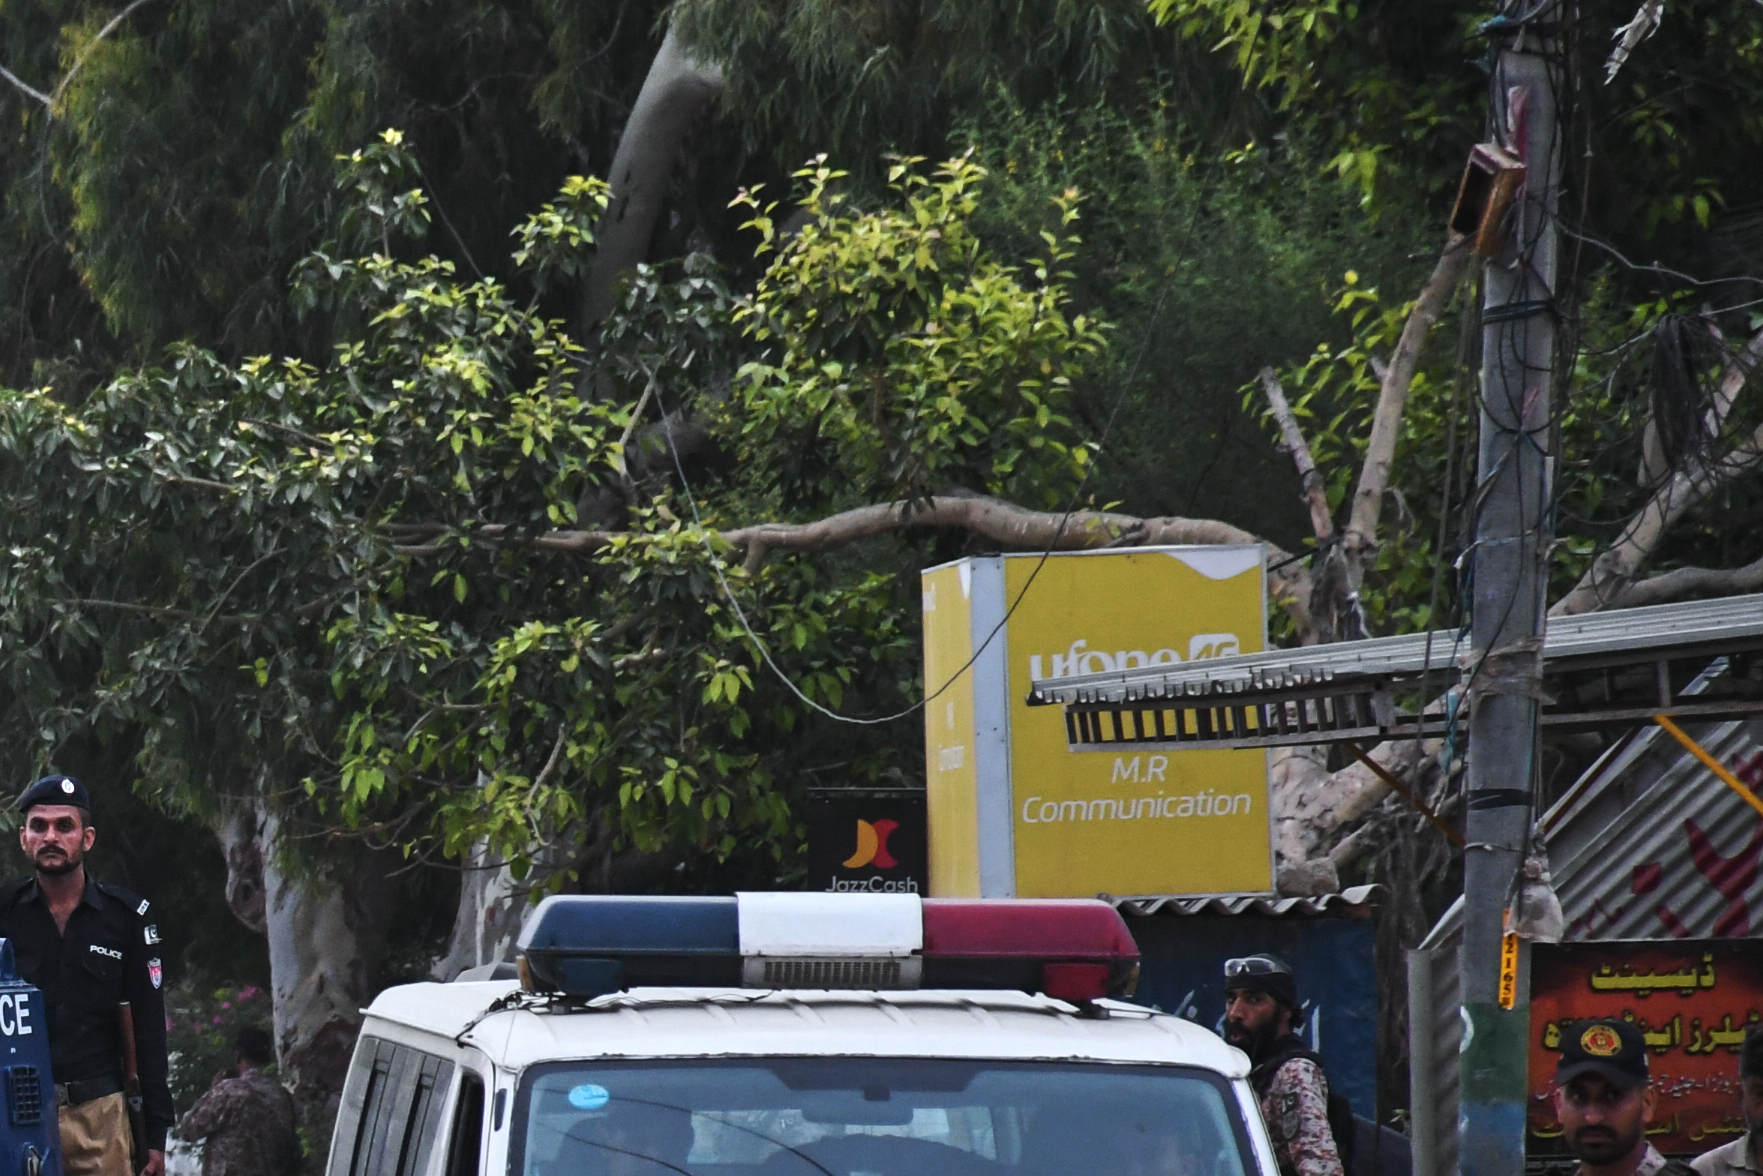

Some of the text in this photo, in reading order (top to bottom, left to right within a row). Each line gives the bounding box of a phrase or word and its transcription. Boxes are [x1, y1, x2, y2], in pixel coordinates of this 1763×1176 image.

[1111, 756, 1168, 784] M.R
[1022, 789, 1252, 824] Communication
[825, 875, 919, 893] JazzCash
[90, 945, 123, 960] POLICE
